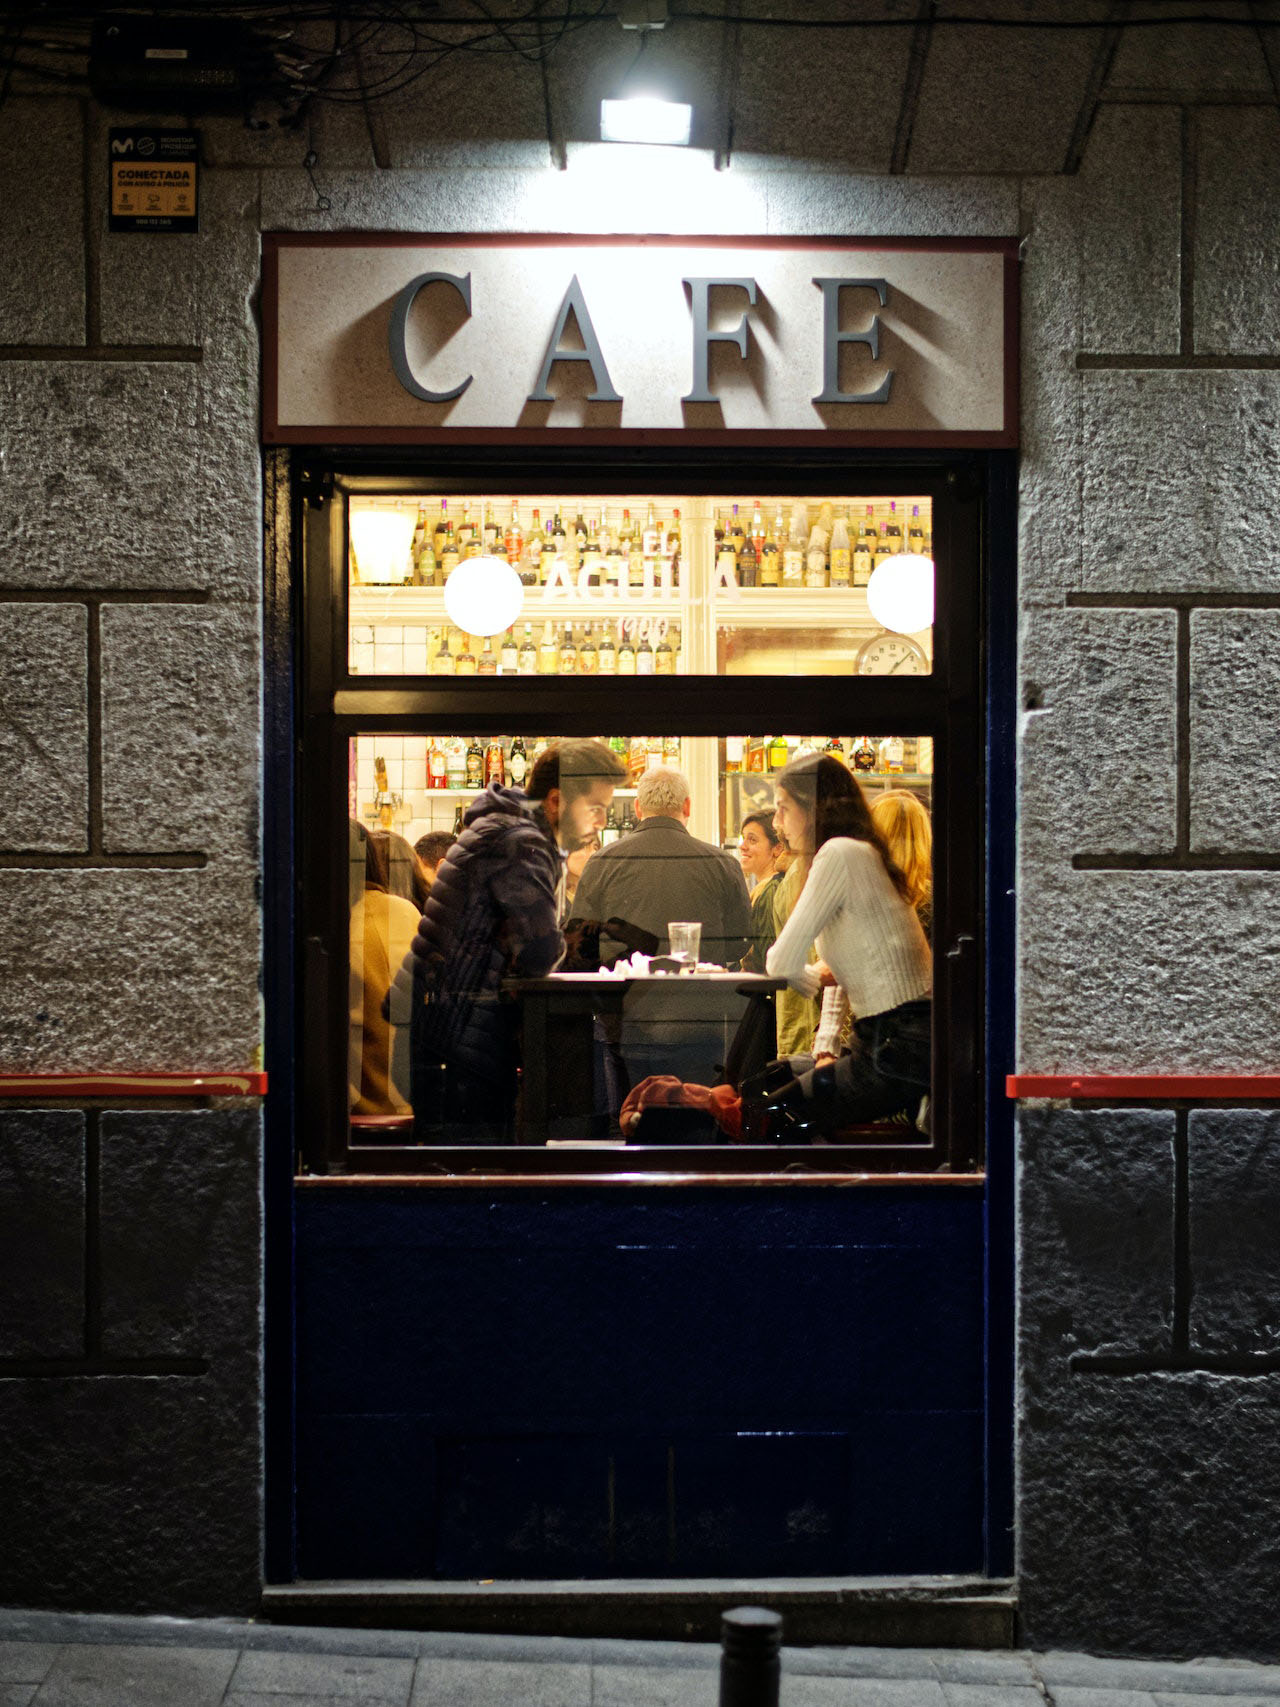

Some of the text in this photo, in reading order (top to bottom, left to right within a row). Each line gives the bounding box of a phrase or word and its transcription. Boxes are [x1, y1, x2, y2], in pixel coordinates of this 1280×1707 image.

[117, 170, 190, 179] CONECTADA
[388, 271, 895, 403] CAFE
[643, 531, 673, 556] EL
